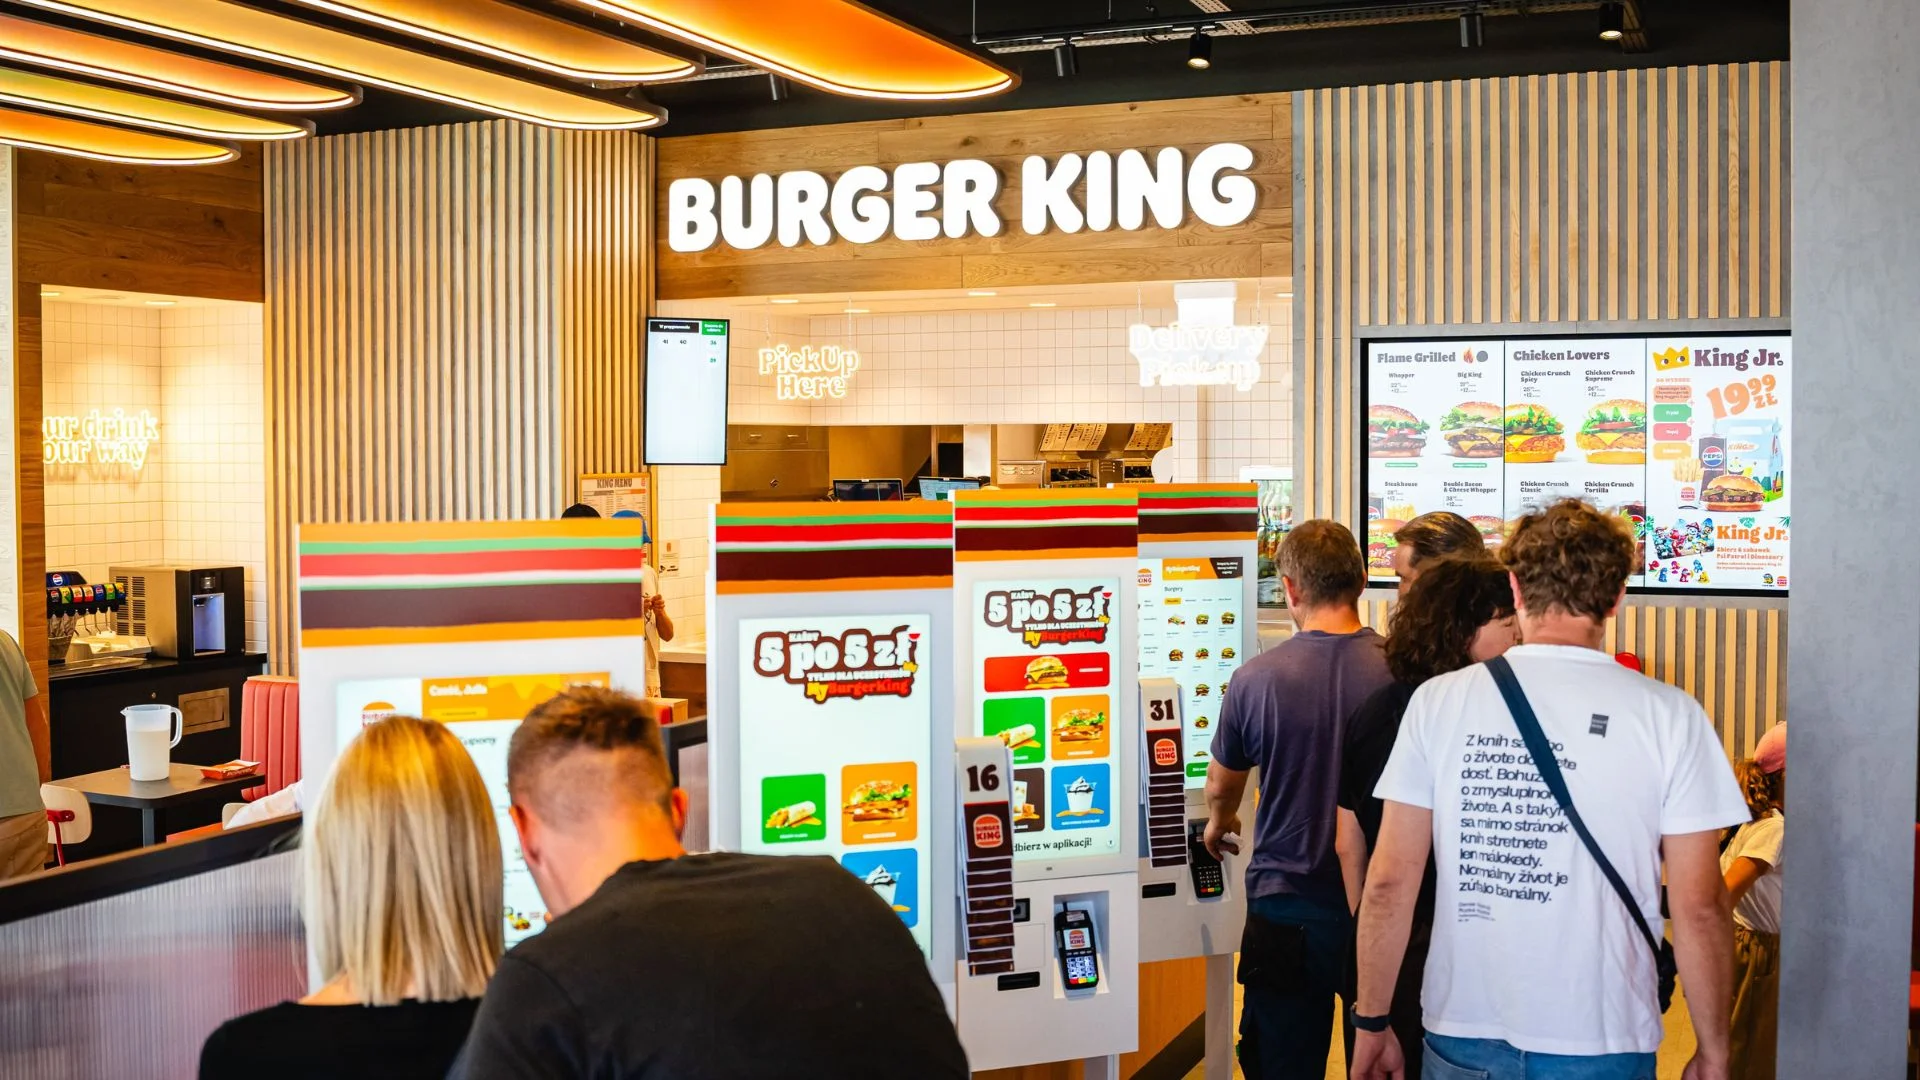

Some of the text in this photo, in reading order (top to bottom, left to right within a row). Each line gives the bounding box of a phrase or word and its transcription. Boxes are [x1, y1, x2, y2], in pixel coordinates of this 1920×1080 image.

[668, 142, 1257, 253] BURGER KING
[1377, 351, 1456, 363] Flame Grilled
[1513, 349, 1610, 361] Chicken Lovers
[1694, 347, 1784, 371] King Jr.
[777, 374, 847, 400] Here
[82, 406, 159, 441] drink
[95, 439, 149, 471] way
[596, 478, 633, 488] KING MENU
[1717, 524, 1761, 544] King
[988, 590, 1106, 629] 5 po 5 zł
[758, 629, 913, 680] 5 po 5 zł
[1150, 698, 1175, 721] 31
[1466, 734, 1475, 747] Z
[1156, 752, 1176, 760] KING
[1463, 753, 1472, 763] o
[1474, 750, 1515, 764] živote
[966, 763, 1000, 792] 16
[1461, 785, 1554, 800] o zmysluplno
[1501, 802, 1513, 814] A
[1515, 804, 1524, 814] s
[1460, 817, 1568, 834] sa mimo stránok
[976, 831, 1001, 841] KING
[1041, 842, 1051, 850] w
[1052, 838, 1093, 851] aplikacji!
[1486, 834, 1548, 850] stretnete
[1460, 849, 1543, 869] len málokedy.
[1518, 869, 1553, 885] život
[1553, 872, 1568, 887] je
[1496, 885, 1552, 904] banálny.
